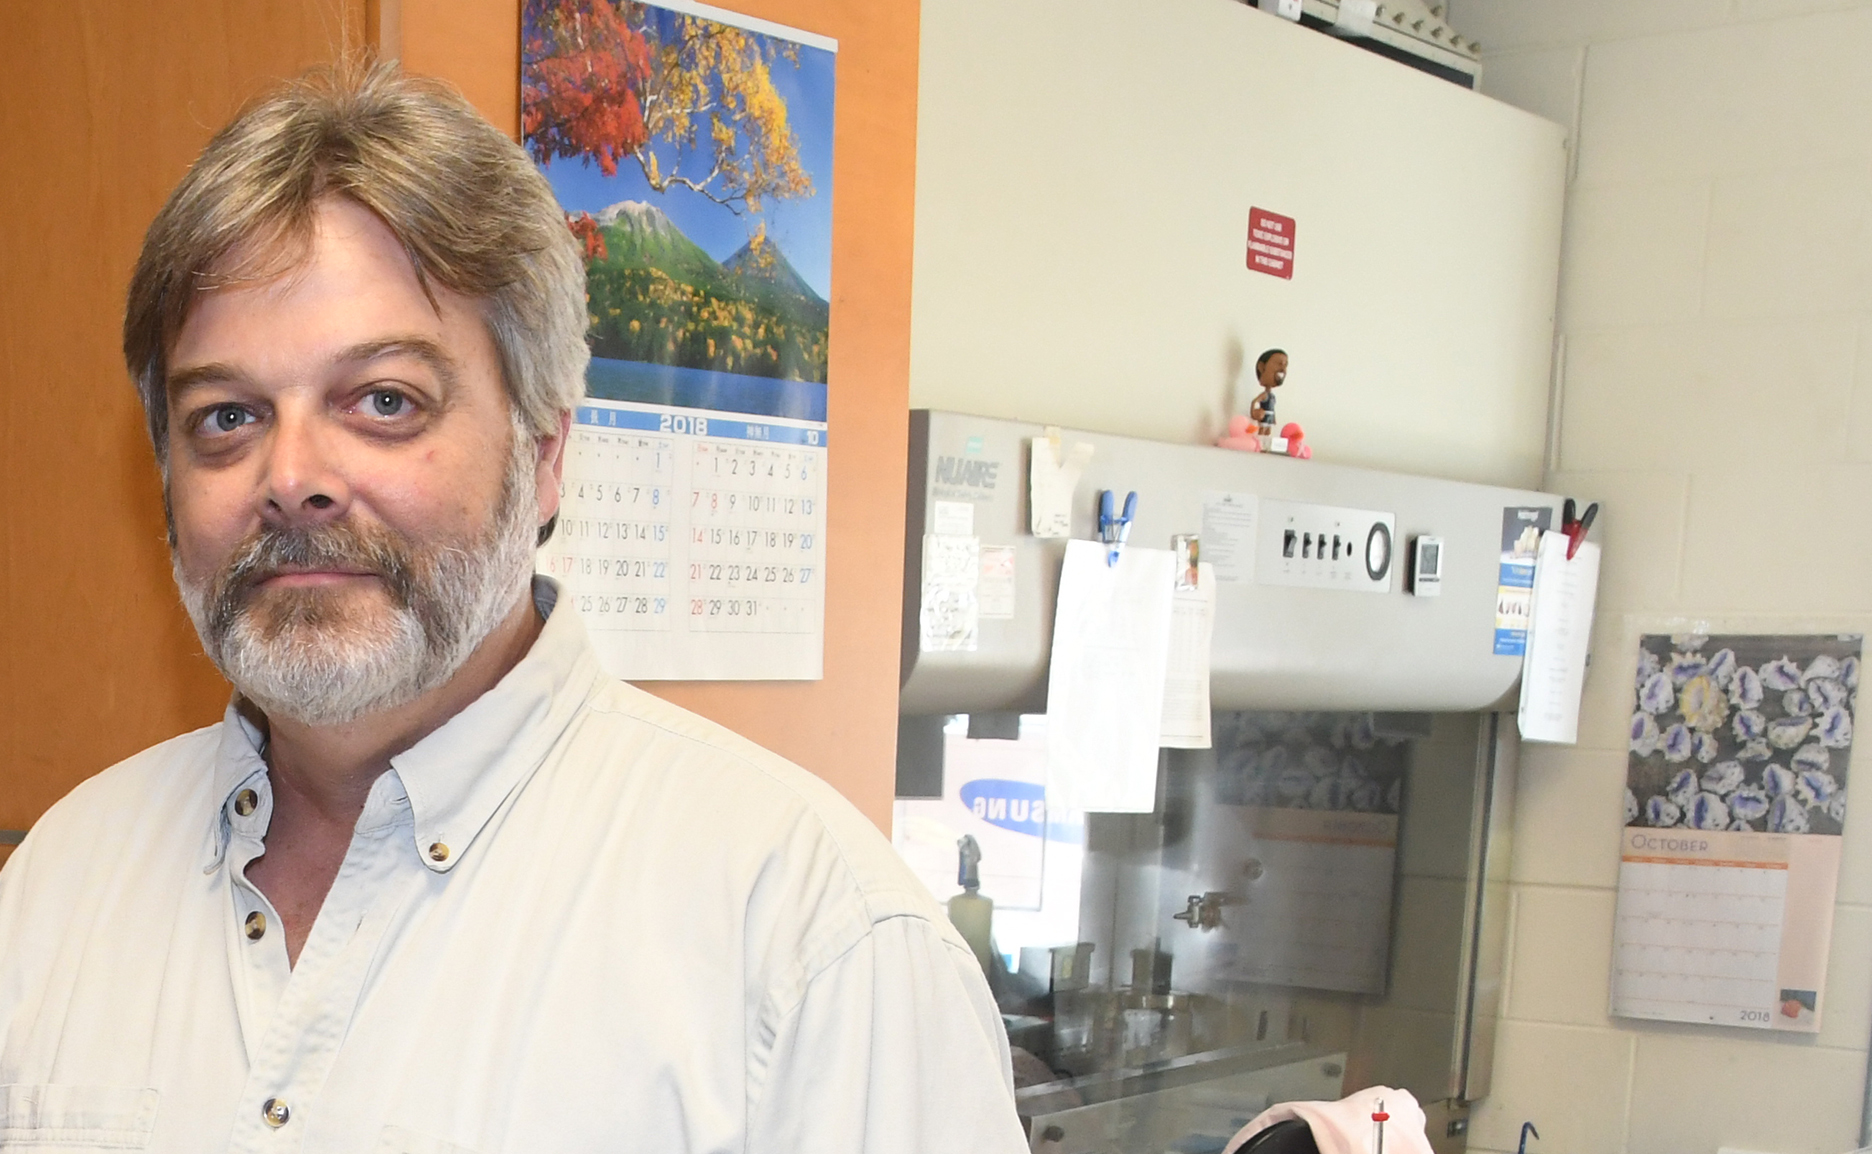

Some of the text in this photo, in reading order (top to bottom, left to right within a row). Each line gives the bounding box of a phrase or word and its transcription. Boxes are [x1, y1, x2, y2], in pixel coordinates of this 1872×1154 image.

[659, 413, 708, 436] 2018
[731, 459, 738, 475] 2
[749, 460, 756, 476] 3
[767, 463, 774, 477] 4
[784, 463, 791, 479] 5
[801, 465, 807, 480] 6
[596, 485, 603, 501] 5
[614, 487, 621, 503] 6
[633, 487, 640, 503] 7
[652, 488, 660, 505] 8
[692, 492, 813, 515] 7 8 9 10 11 12 13
[598, 522, 609, 539] 12
[616, 523, 628, 540] 13
[635, 524, 646, 540] 14
[653, 525, 665, 541] 15
[692, 527, 813, 549] 14 15 16 17 18 19 20
[616, 560, 629, 577] 20
[634, 561, 646, 577] 21
[653, 561, 665, 578] 22
[691, 563, 812, 584] 21 22 23 24 25 26 27
[616, 596, 628, 613] 27
[635, 597, 648, 614] 28
[691, 599, 758, 616] 28 29 30 31
[1740, 1010, 1771, 1023] 2018
